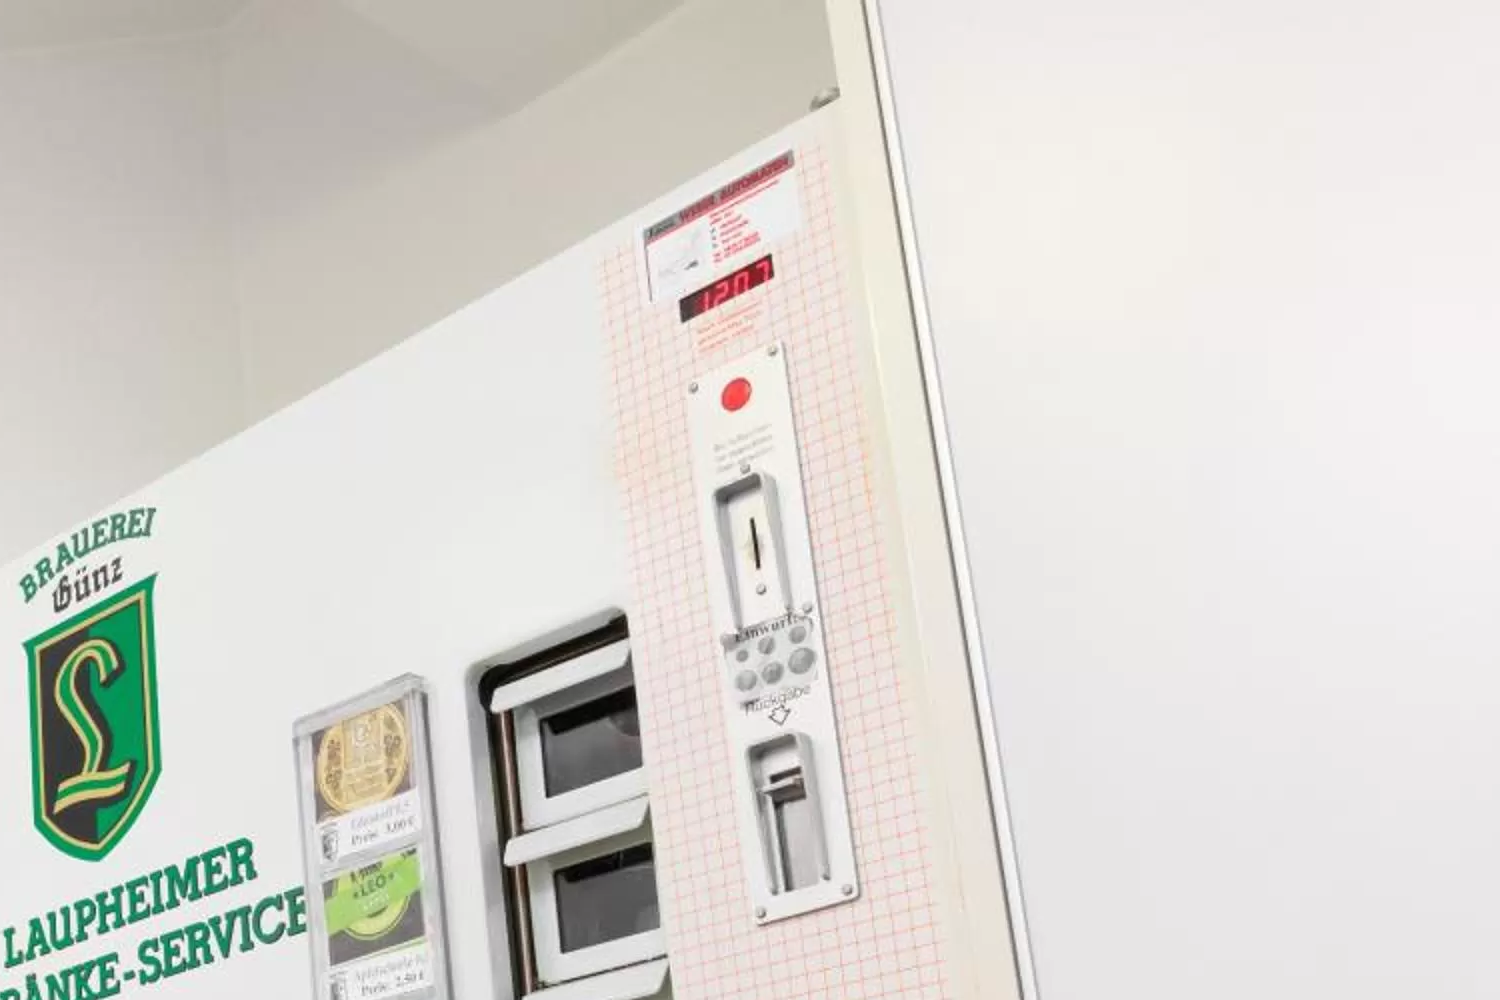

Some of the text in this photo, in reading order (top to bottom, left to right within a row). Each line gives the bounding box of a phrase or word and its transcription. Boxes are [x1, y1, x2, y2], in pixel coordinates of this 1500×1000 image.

[19, 507, 157, 604] BRAUEREI
[52, 557, 125, 613] Günz
[4, 837, 259, 968] LAUPHEIMER
